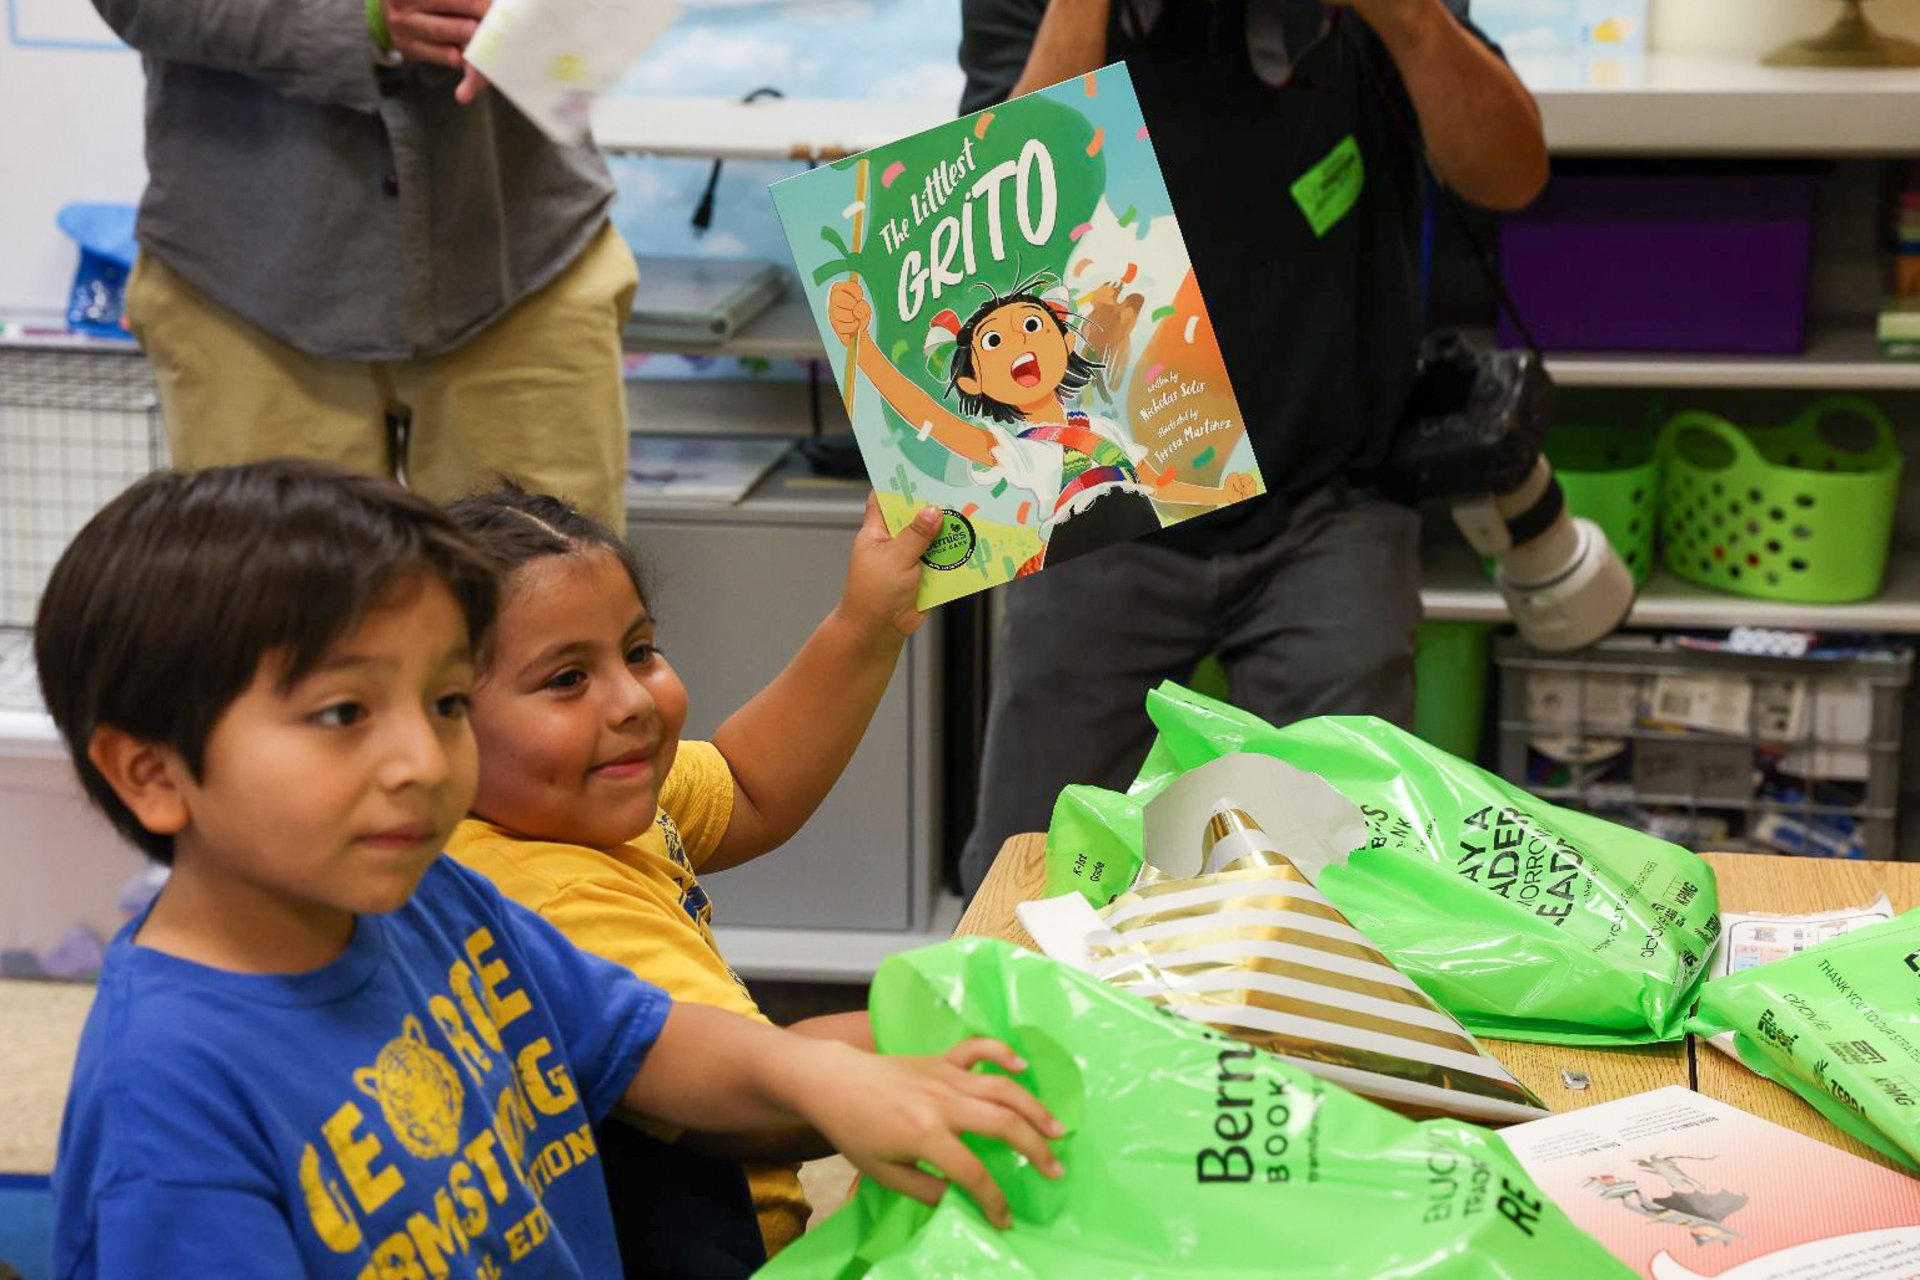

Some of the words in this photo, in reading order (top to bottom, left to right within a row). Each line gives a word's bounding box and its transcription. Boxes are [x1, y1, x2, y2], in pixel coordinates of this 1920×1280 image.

[878, 218, 910, 255] The
[1140, 391, 1178, 421] Nicholas
[1180, 380, 1206, 397] Solis
[1154, 437, 1184, 464] Teresa
[1463, 805, 1494, 831] A
[1674, 881, 1699, 907] KPMG
[1817, 958, 1848, 993] THANK
[1846, 990, 1870, 1011] YOU
[1264, 1079, 1292, 1183] BOOK
